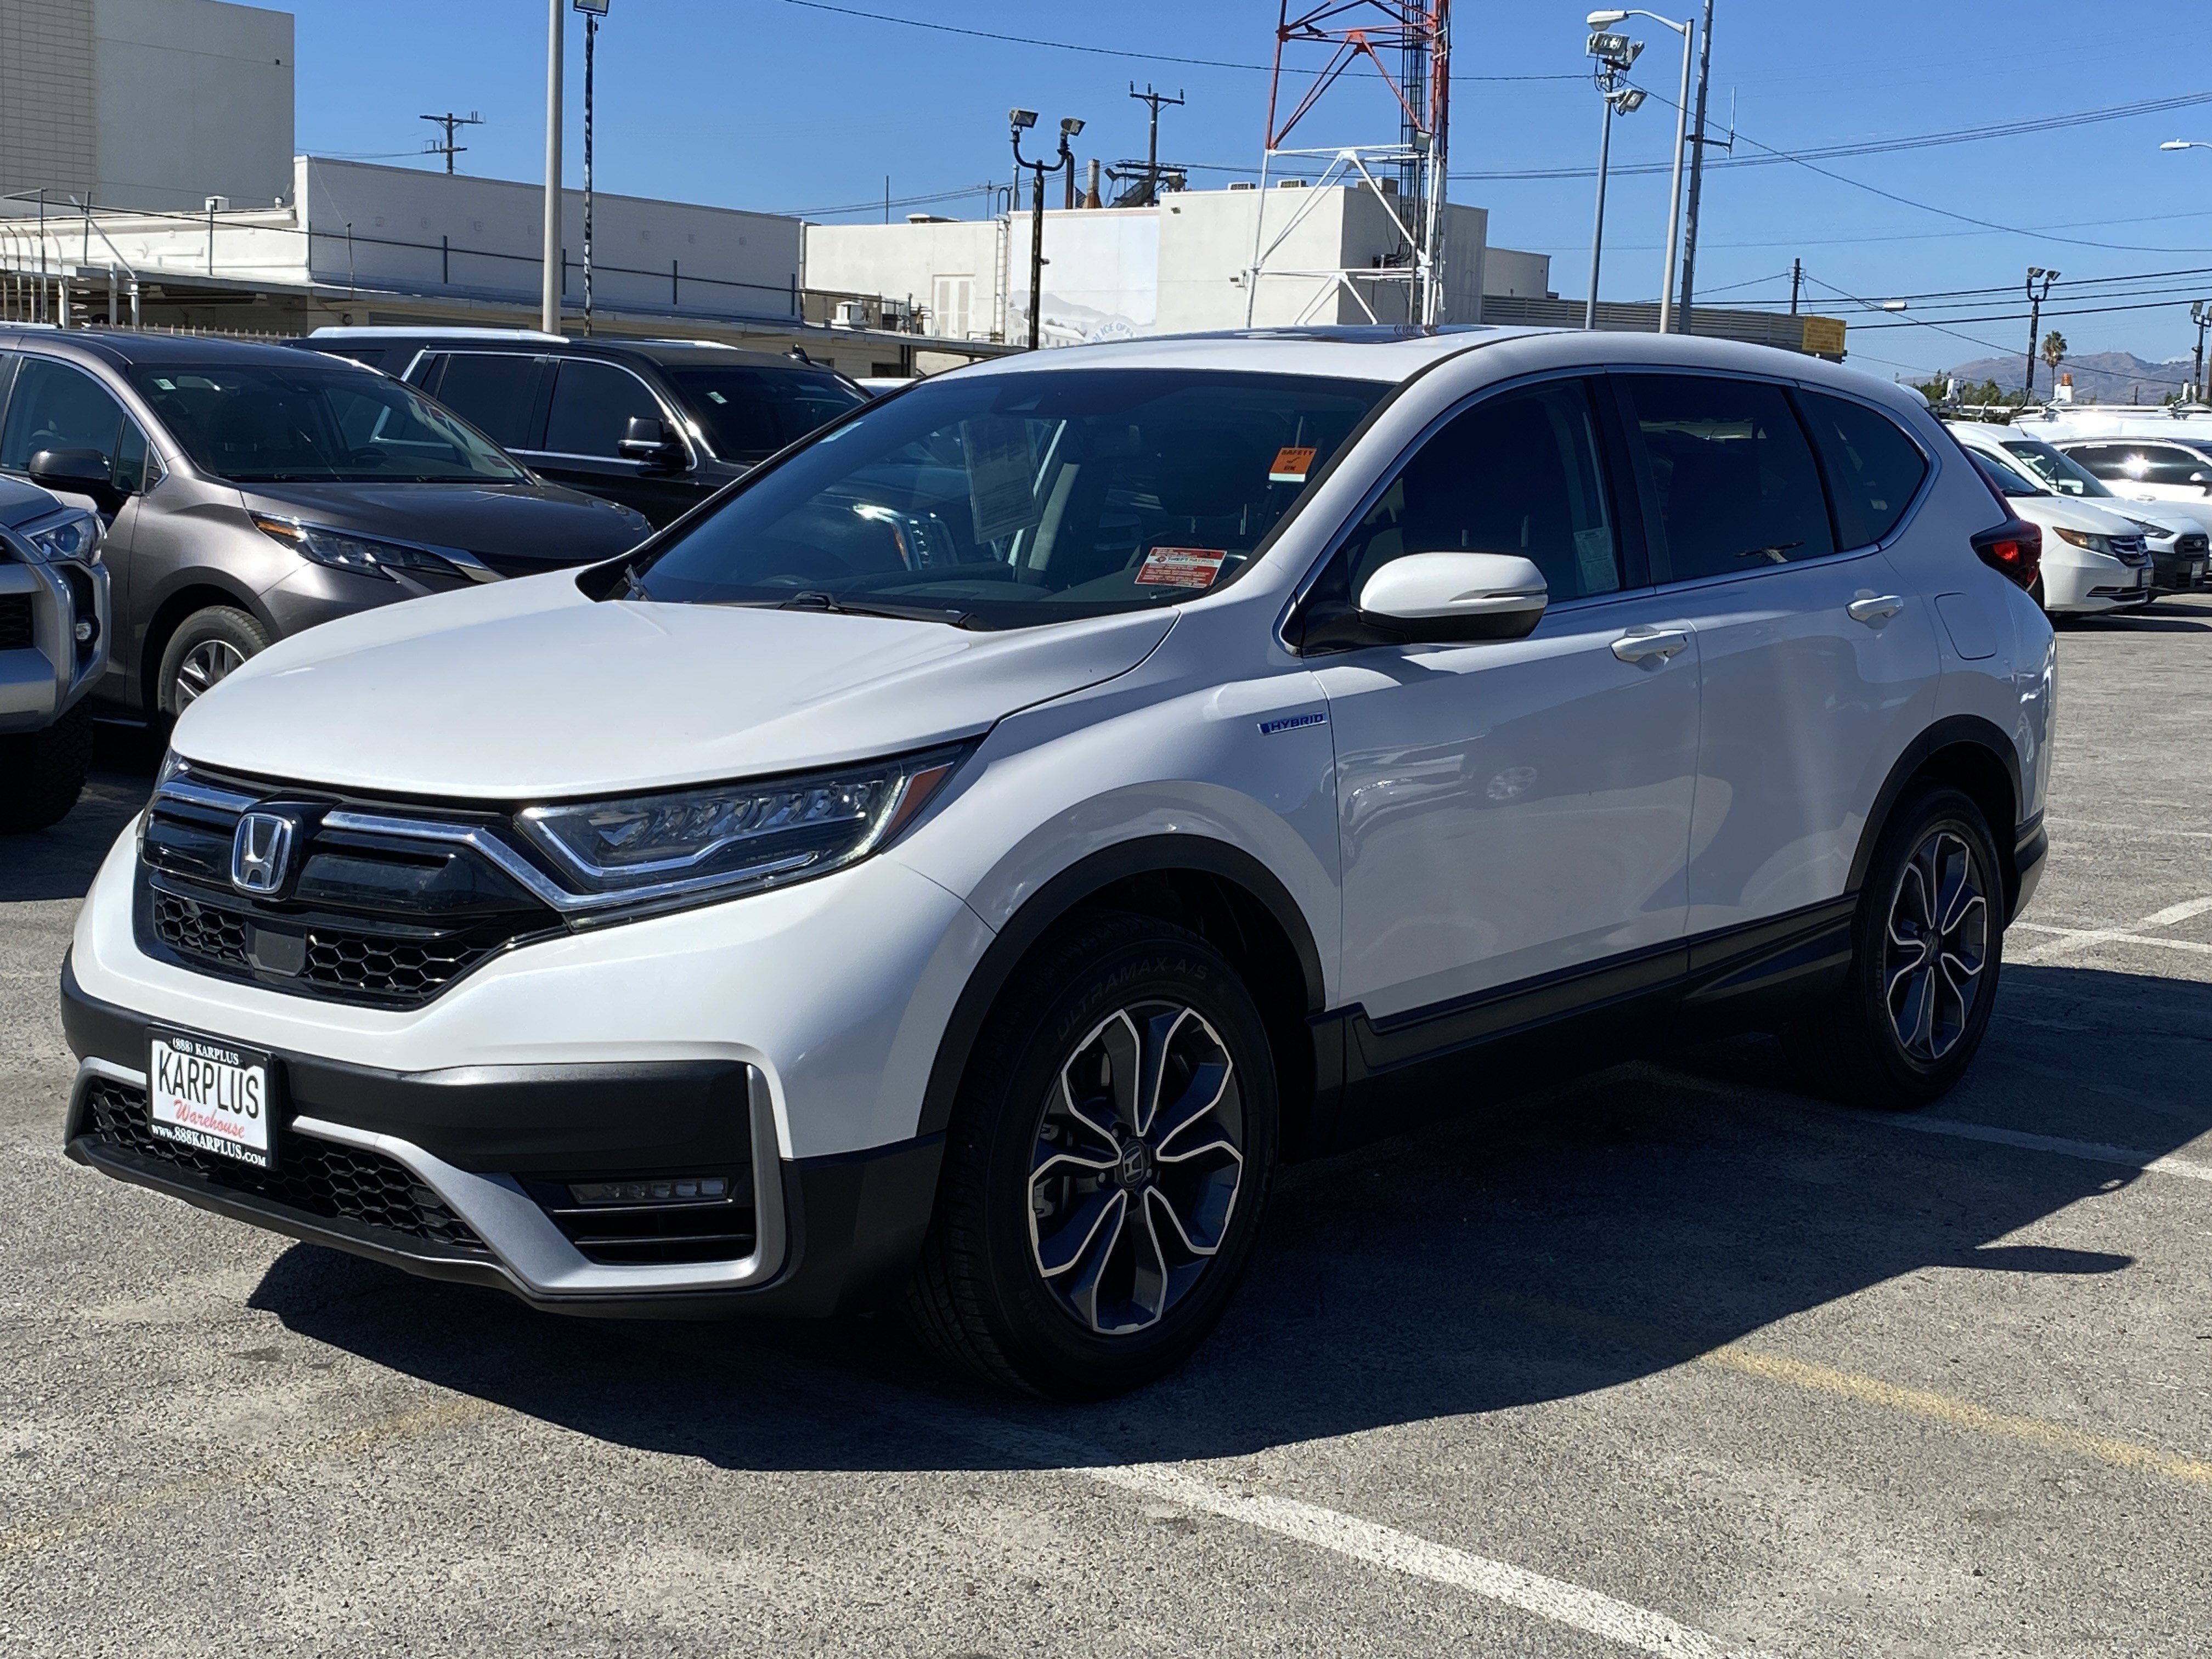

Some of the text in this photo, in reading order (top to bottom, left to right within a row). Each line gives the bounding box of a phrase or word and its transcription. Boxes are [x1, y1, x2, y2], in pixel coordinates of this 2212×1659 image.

[1271, 713, 1324, 731] HYBRID
[1057, 956, 1209, 1041] ULTRAMAX A/S
[172, 1037, 239, 1065] (888) KARPLUS
[159, 1048, 259, 1120] KARPLUS
[173, 1098, 245, 1139] Warehouse
